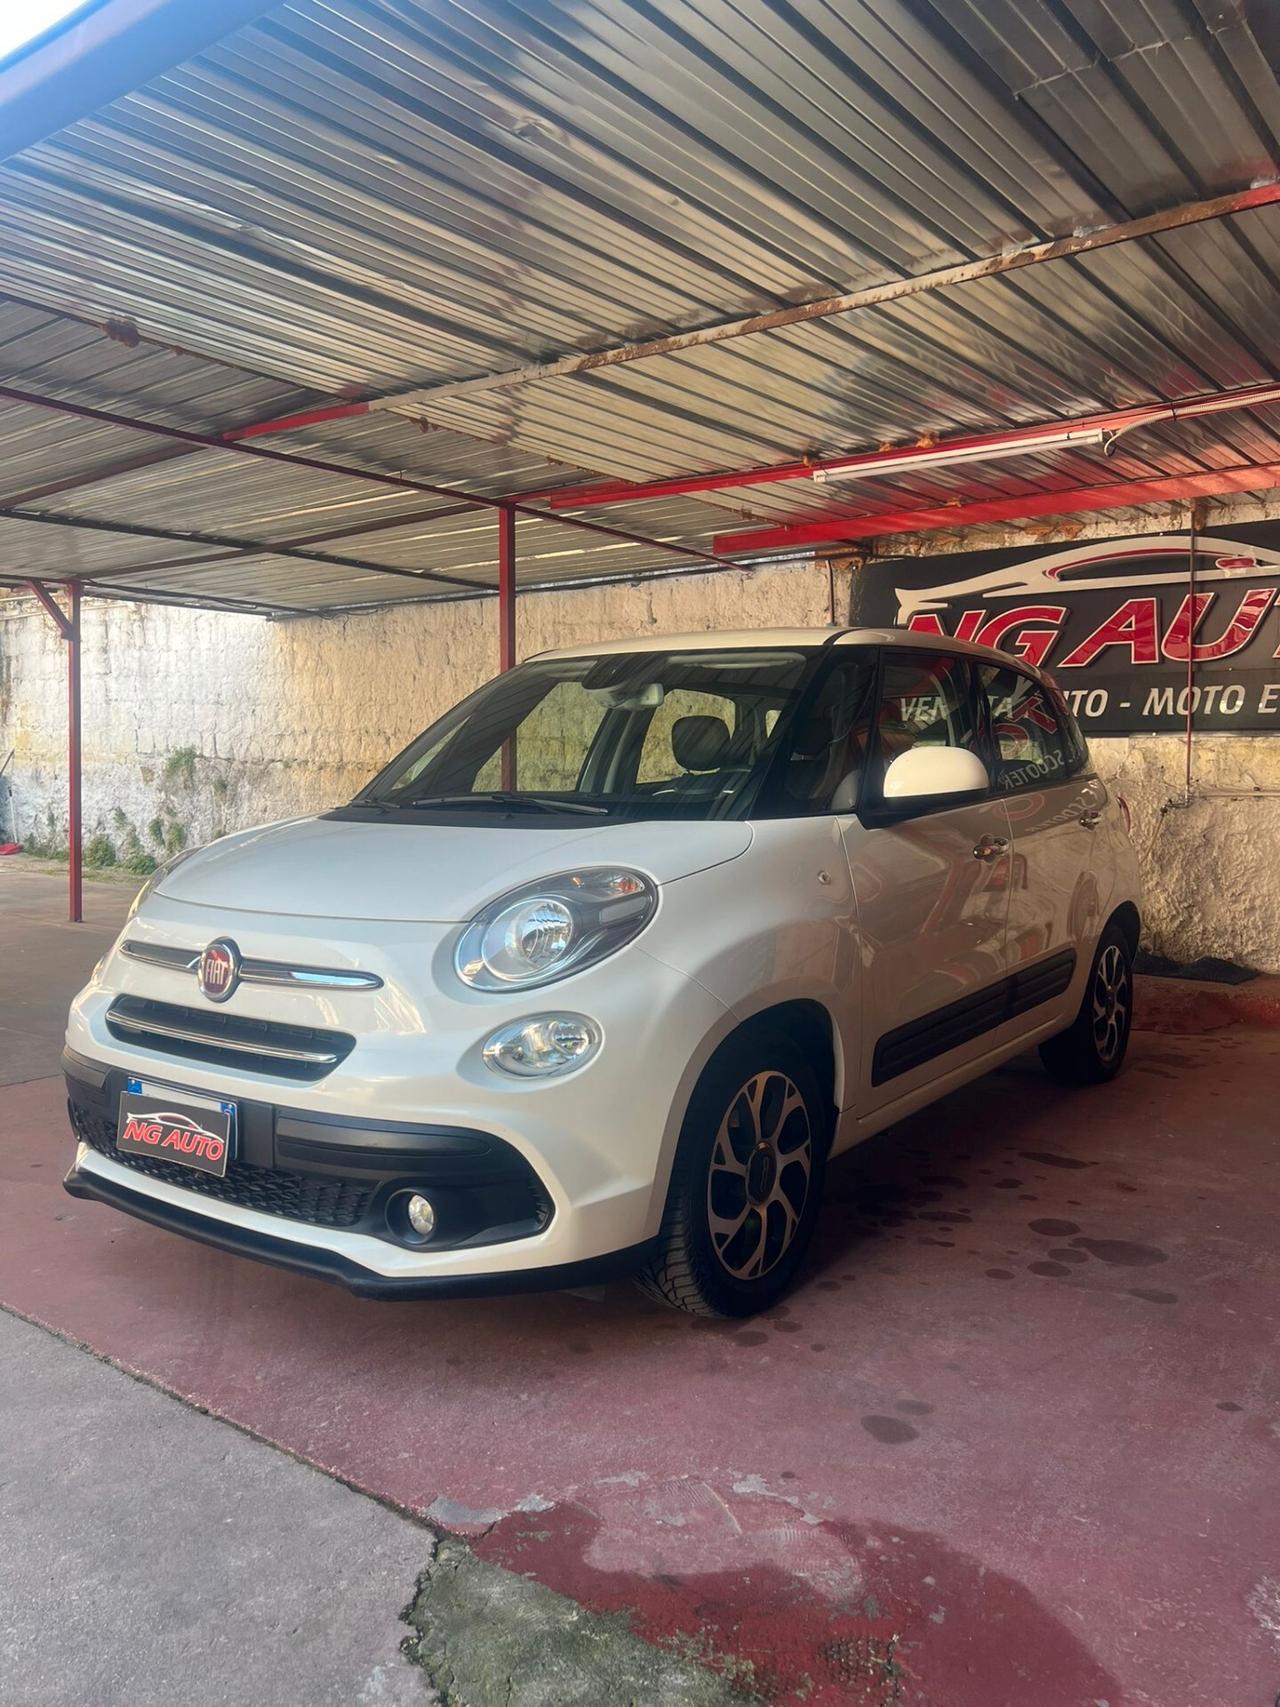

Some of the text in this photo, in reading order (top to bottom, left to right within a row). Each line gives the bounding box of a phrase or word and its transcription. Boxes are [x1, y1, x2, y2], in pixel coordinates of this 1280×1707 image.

[1057, 587, 1280, 669] AU
[1142, 684, 1246, 716] MOTO
[205, 958, 229, 985] FIAT
[122, 1119, 225, 1162] NG AUTO
